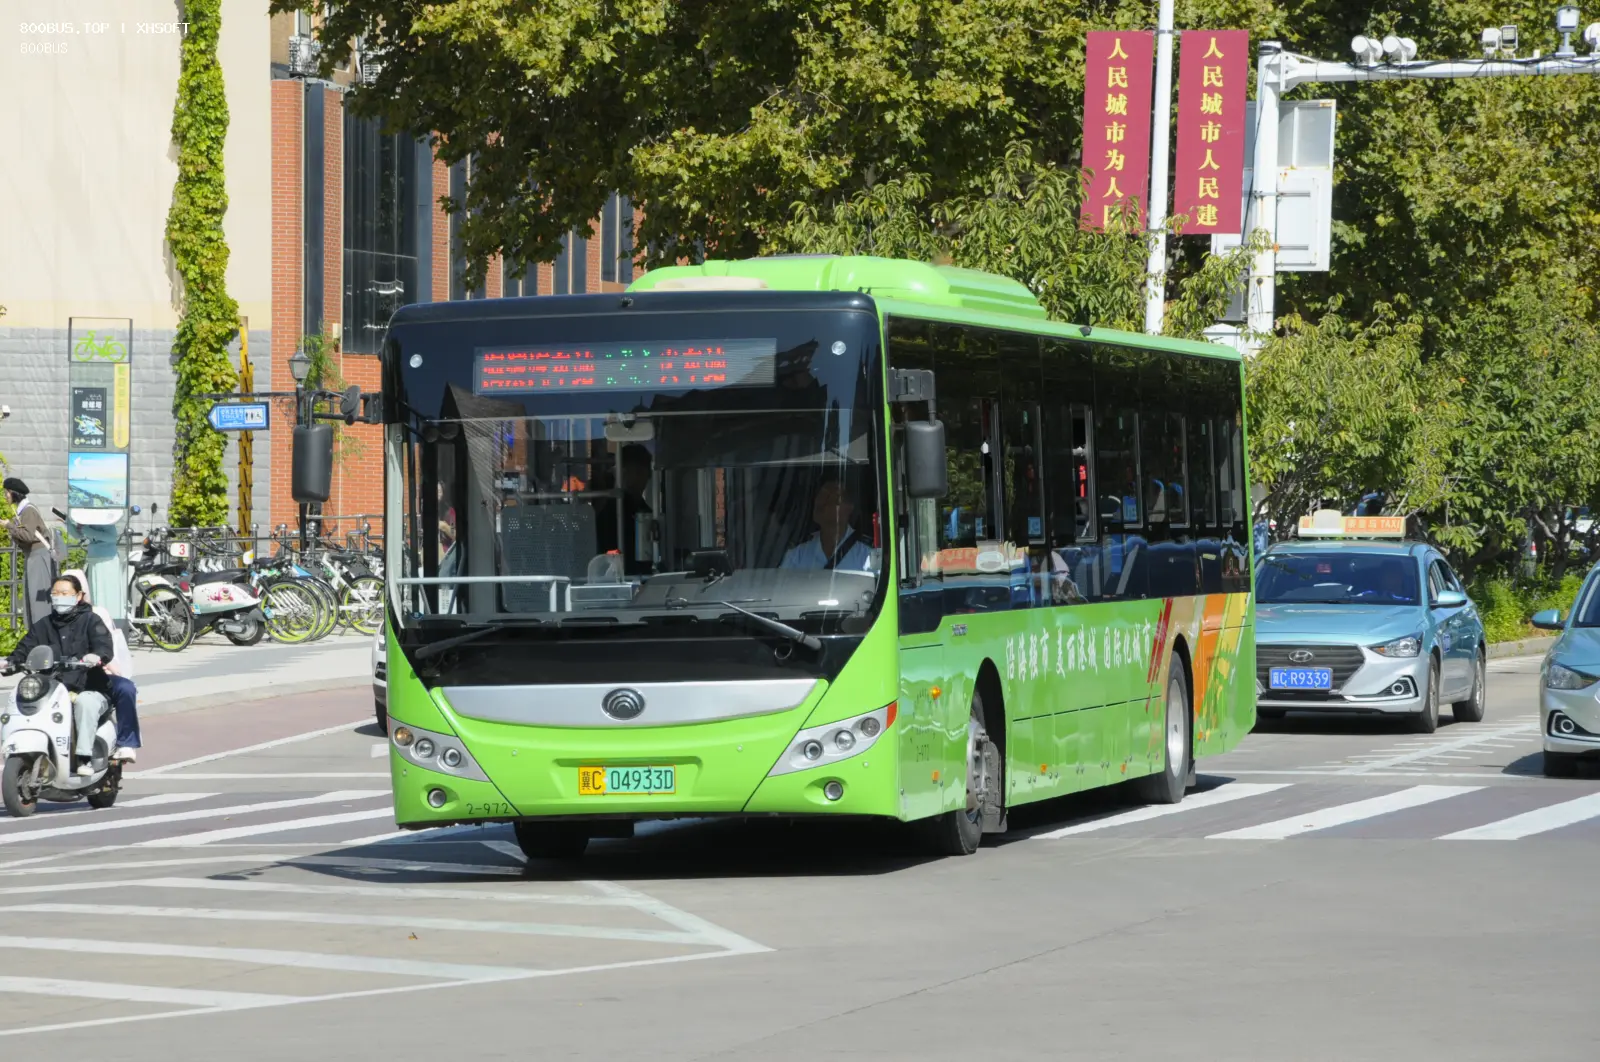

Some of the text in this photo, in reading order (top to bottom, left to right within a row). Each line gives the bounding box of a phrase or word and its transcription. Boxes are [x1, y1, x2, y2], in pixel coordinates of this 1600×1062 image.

[1196, 37, 1225, 227] 人民城市人民建
[1381, 518, 1400, 529] TAXI
[466, 802, 511, 815] 2-972
